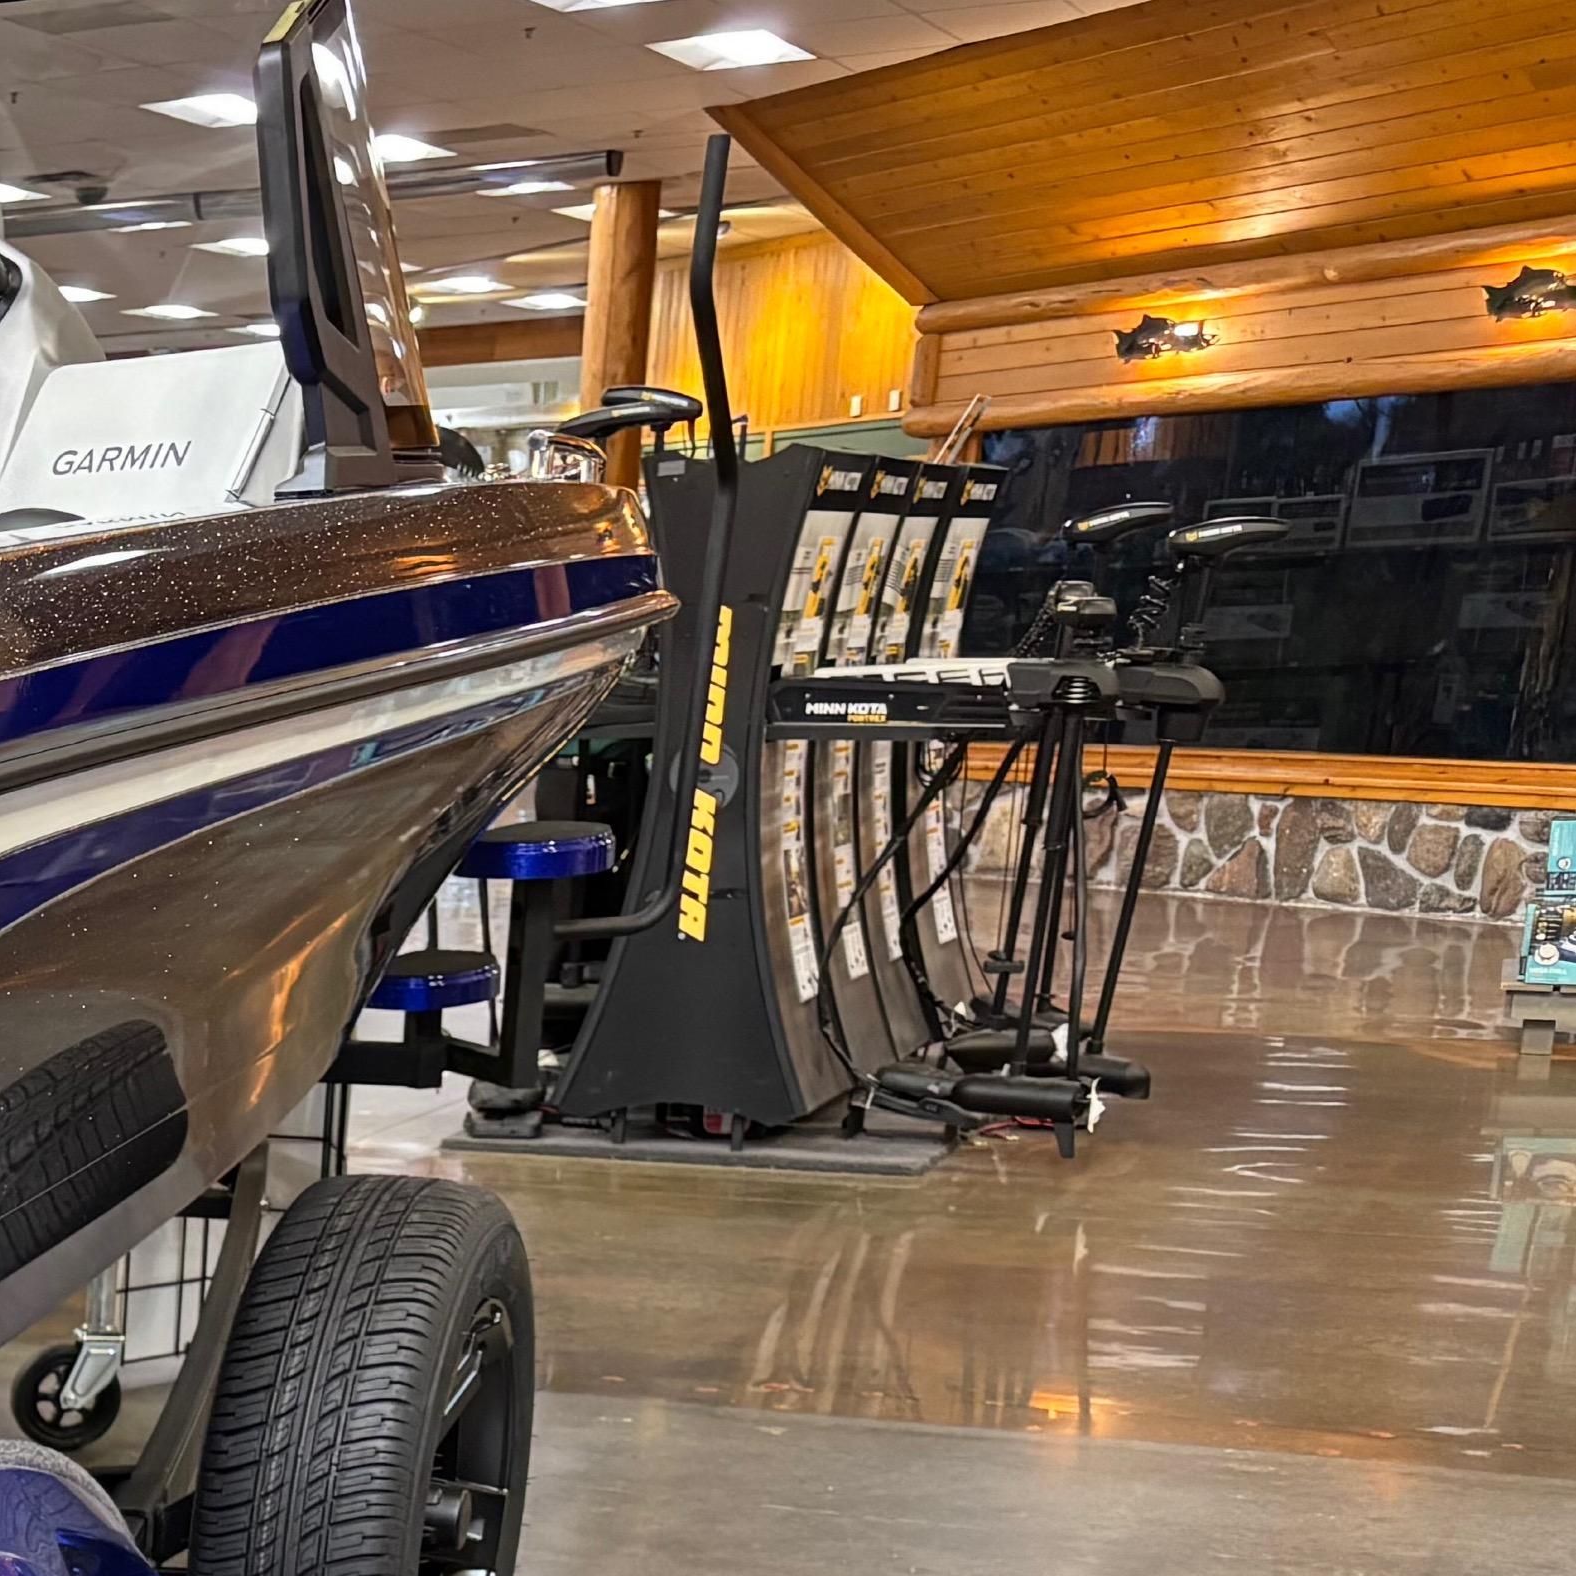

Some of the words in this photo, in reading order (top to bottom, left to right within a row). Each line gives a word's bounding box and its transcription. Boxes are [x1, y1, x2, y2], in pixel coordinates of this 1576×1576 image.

[52, 440, 192, 476] GARMIN
[805, 702, 847, 715] MINN
[847, 702, 888, 715] KOTA
[678, 788, 717, 943] KOTA
